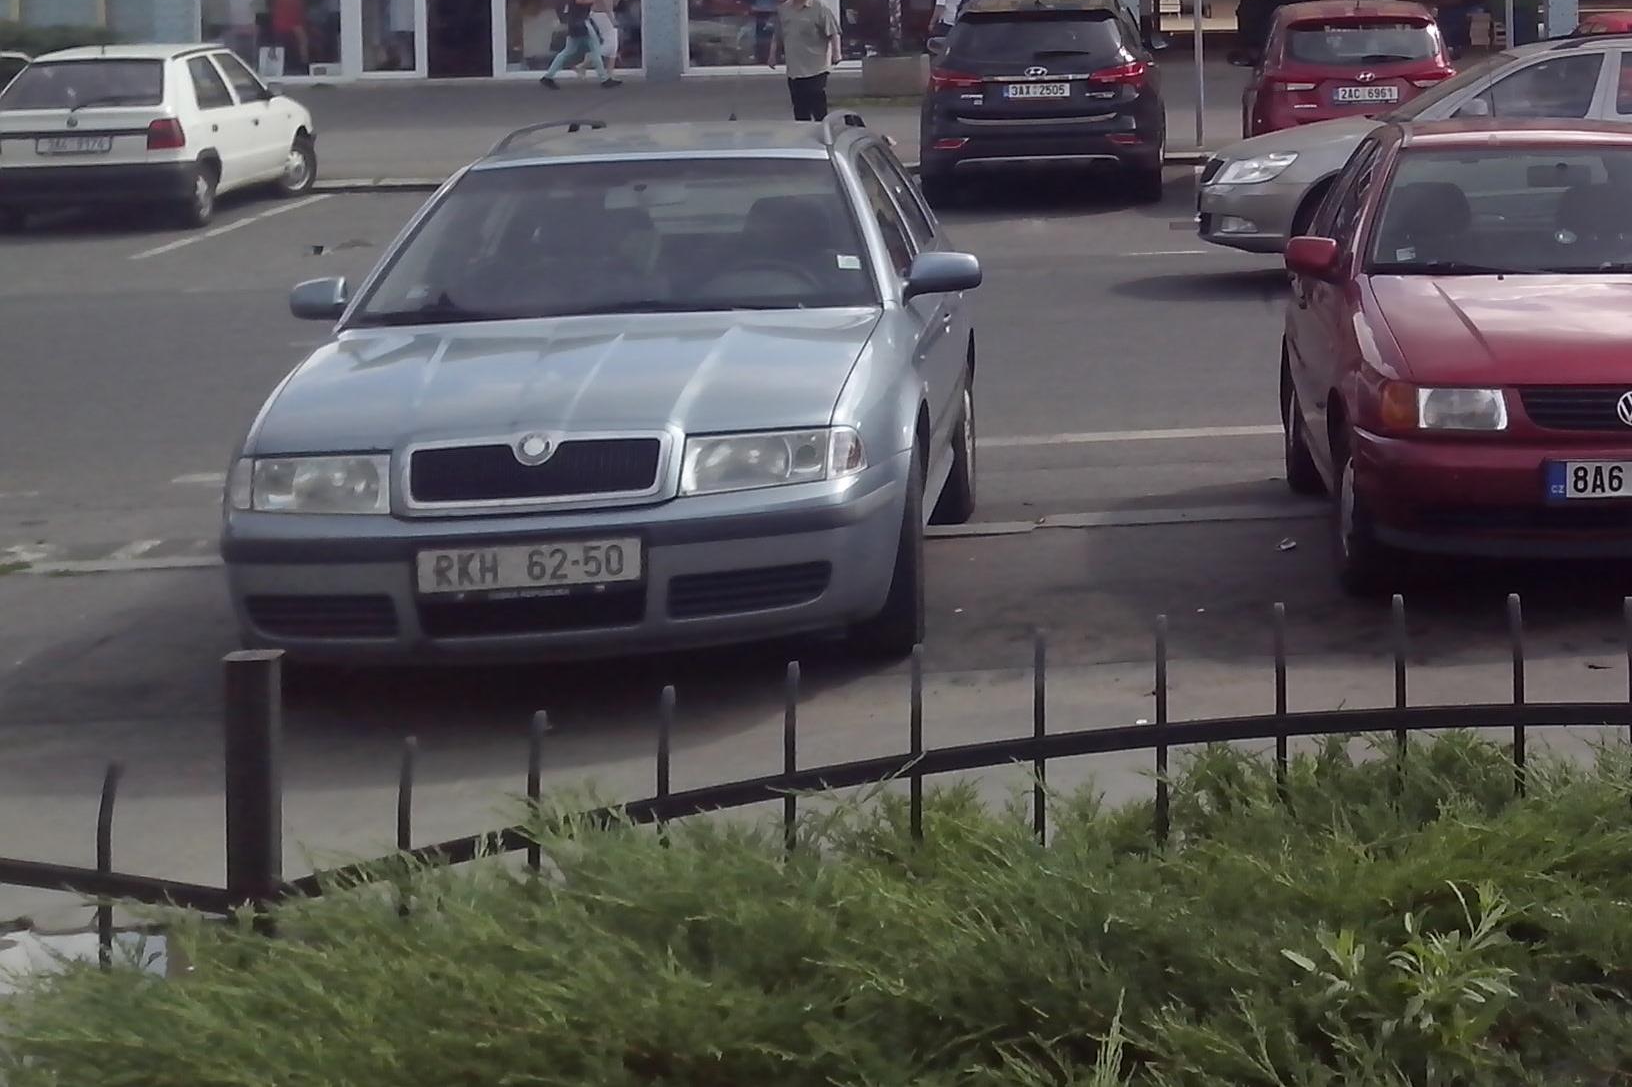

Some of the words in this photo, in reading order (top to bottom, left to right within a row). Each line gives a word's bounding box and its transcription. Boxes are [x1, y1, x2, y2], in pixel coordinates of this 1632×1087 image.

[1551, 484, 1565, 494] CZ
[1572, 465, 1624, 493] 8A6
[433, 553, 500, 587] RKH
[525, 544, 625, 581] 62-50
